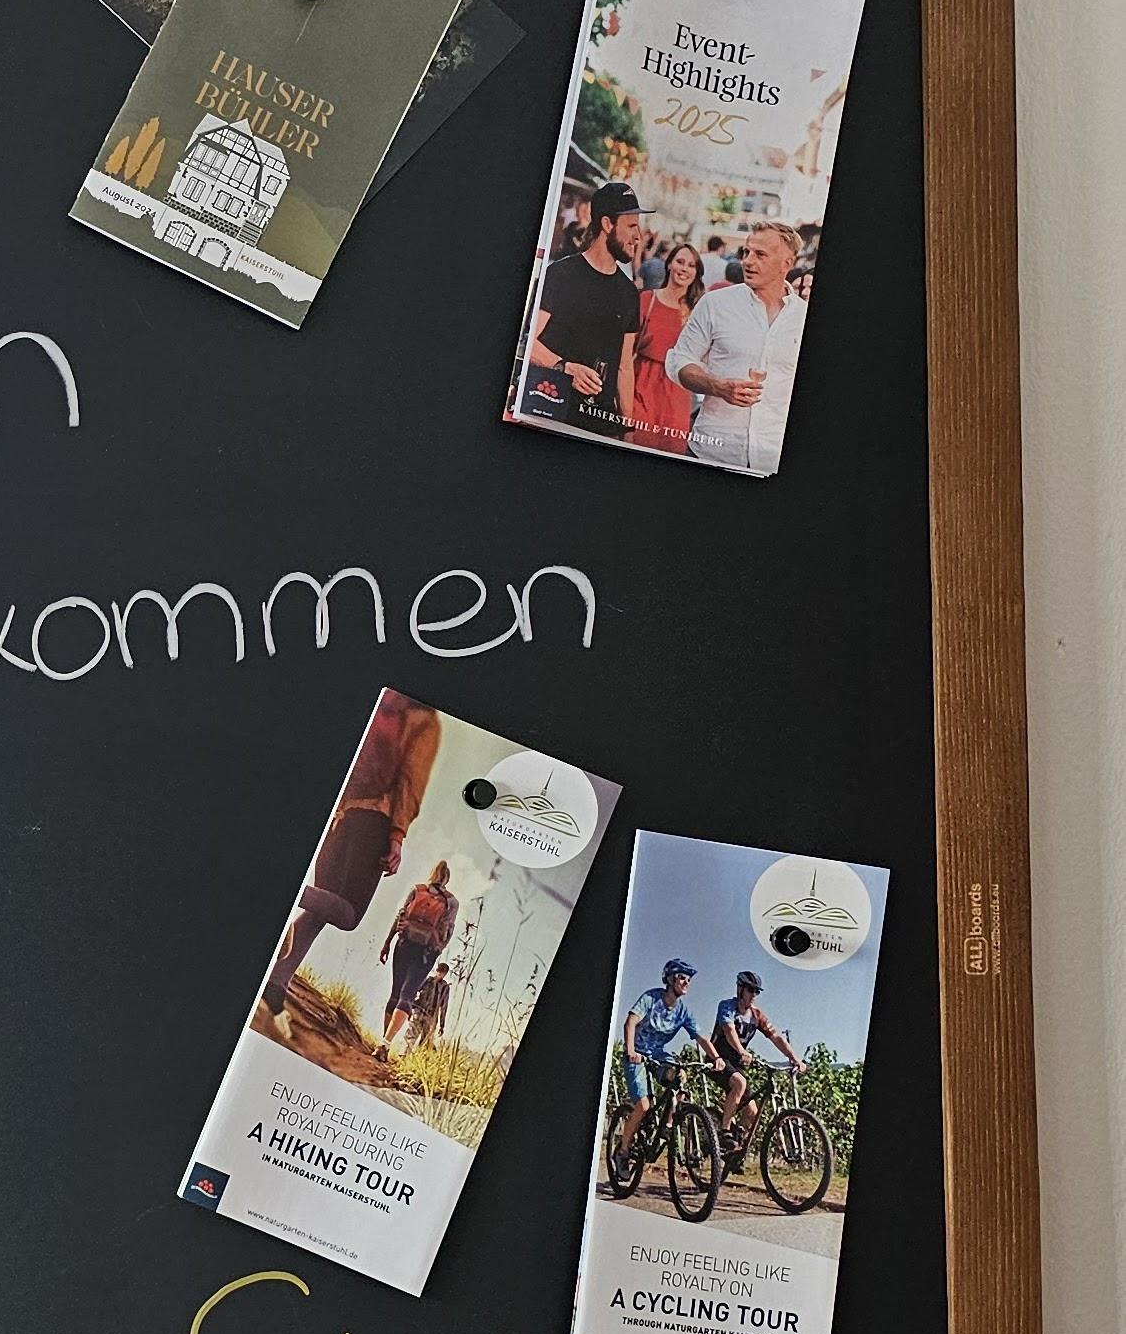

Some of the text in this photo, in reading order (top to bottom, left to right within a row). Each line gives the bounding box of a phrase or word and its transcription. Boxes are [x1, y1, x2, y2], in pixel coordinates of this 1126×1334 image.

[673, 22, 755, 65] Event-
[210, 50, 335, 128] HAUSER
[641, 45, 781, 105] Highlights
[195, 80, 320, 160] BÜHLER
[654, 98, 749, 145] 2025
[102, 186, 157, 218] August 2024
[240, 254, 286, 281] KAISERSTUHL
[578, 403, 651, 433] KAISERSTUHL
[652, 425, 661, 434] &
[663, 426, 724, 447] TUNIBERG
[489, 821, 561, 857] KAISERSTUHL
[270, 1082, 428, 1159] ENJOY FEELING LIKE
[276, 1107, 405, 1171] ROYALTY DURING
[247, 1122, 415, 1206] A HIKING TOUR
[261, 1153, 391, 1214] IN NATURGARTEN KAISERSTUHL
[247, 1209, 358, 1260] www.naturgarten-kaiserstuhl.de
[631, 1246, 791, 1282] ENJOY FEELING LIKE
[661, 1271, 753, 1297] ROYALTY ON
[610, 1288, 799, 1333] A CYCLING TOUR
[622, 1317, 662, 1329] THROUGH
